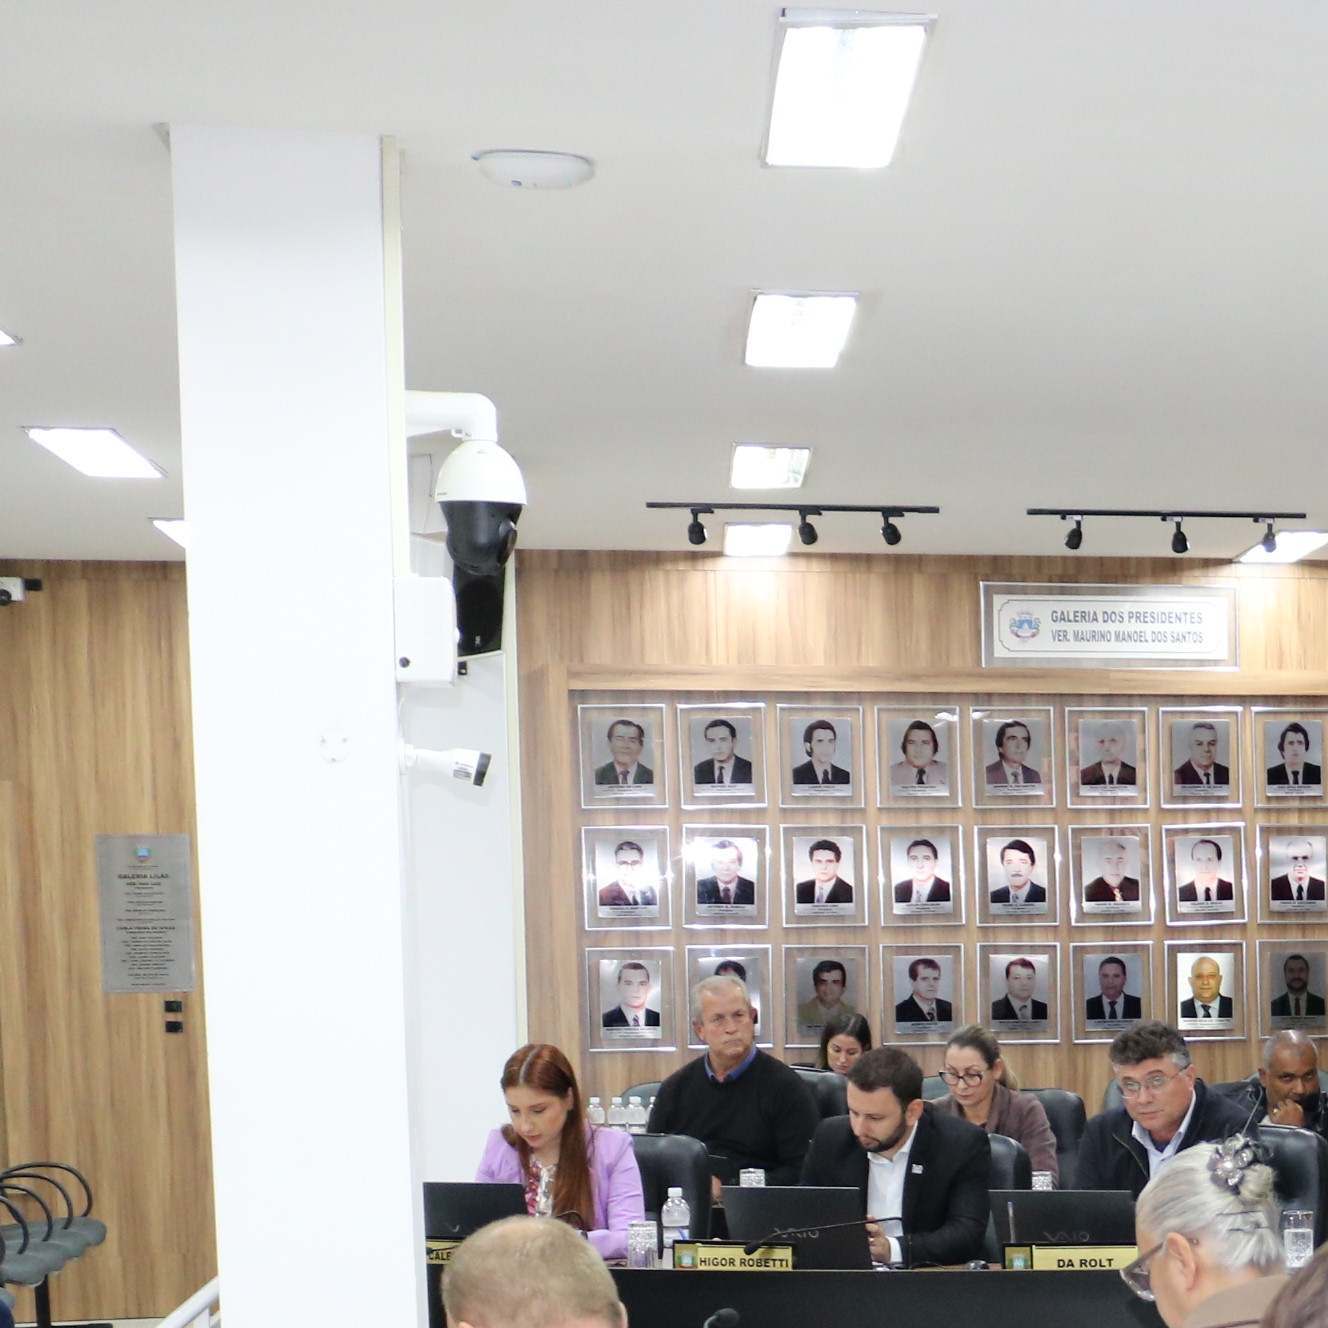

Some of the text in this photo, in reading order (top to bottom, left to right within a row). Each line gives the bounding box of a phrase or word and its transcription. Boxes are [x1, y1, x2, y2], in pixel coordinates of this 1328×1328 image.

[1051, 610, 1203, 624] GALERIA DOS PRESIDENTES
[1051, 630, 1203, 643] VER. MAURINO MANOEL DOS SANTOS
[1043, 1231, 1090, 1242] VAIO
[699, 1257, 789, 1268] HIGOR ROBETTI
[1057, 1258, 1114, 1268] DA ROLT
